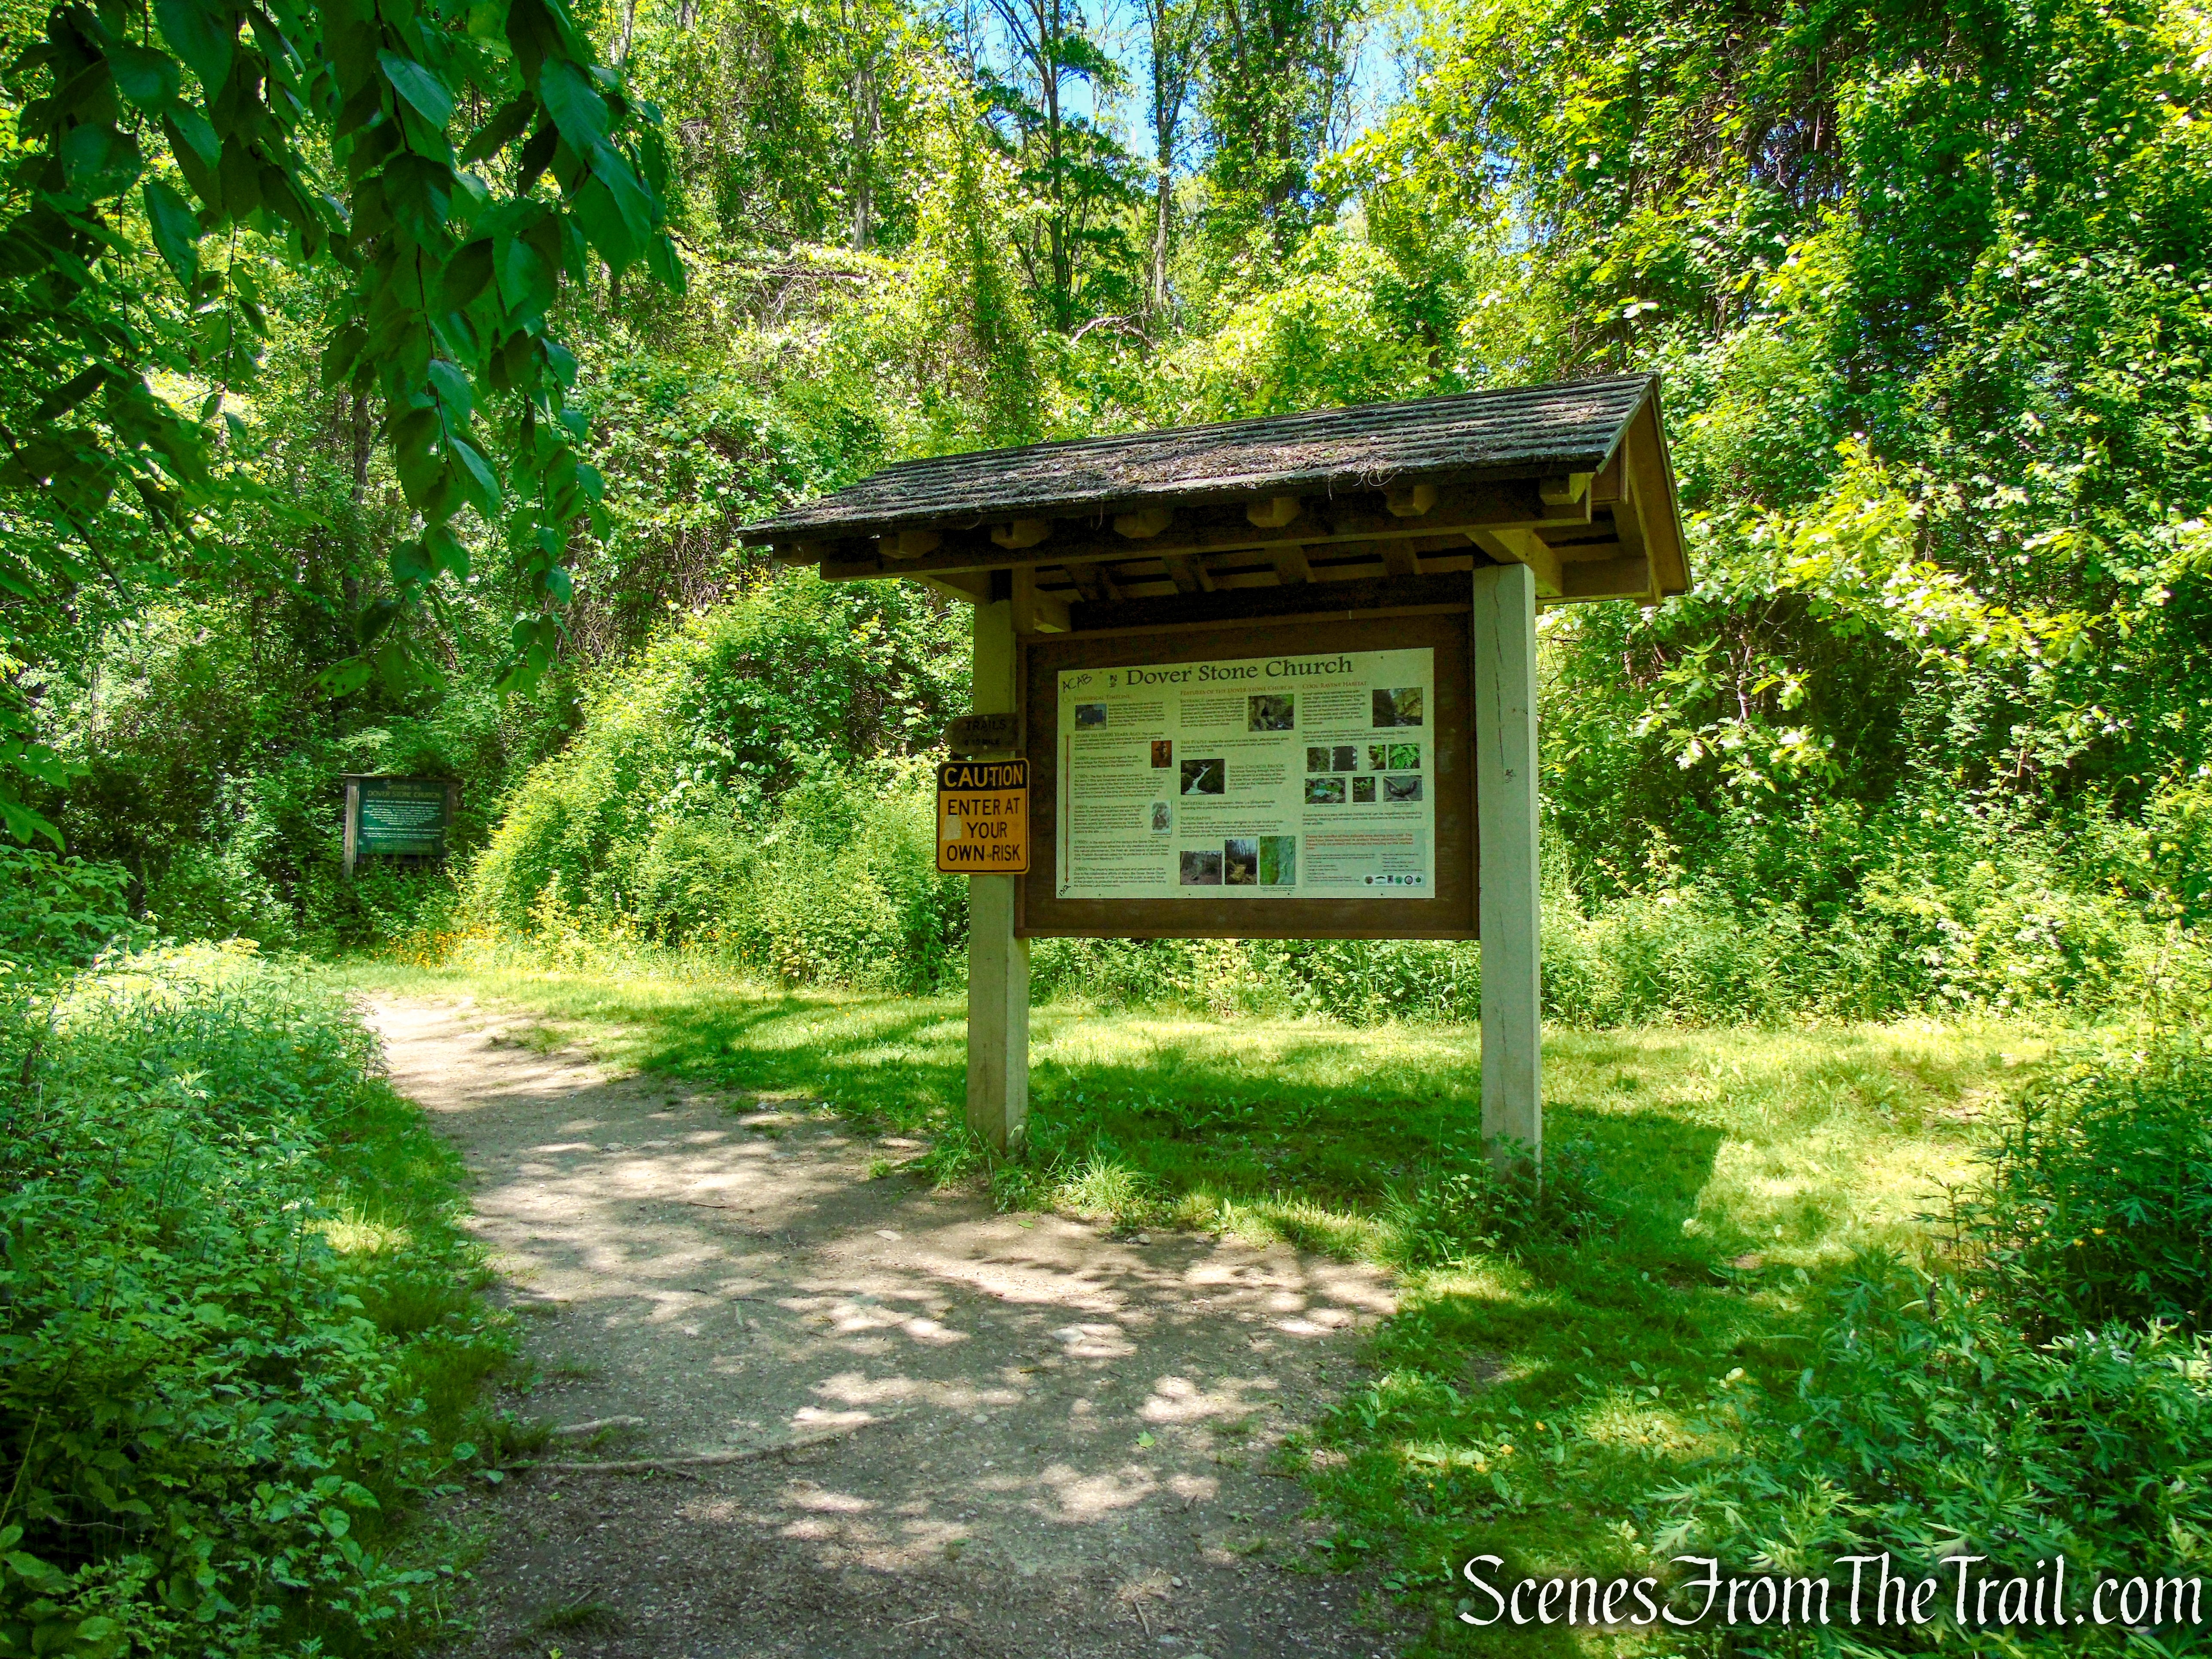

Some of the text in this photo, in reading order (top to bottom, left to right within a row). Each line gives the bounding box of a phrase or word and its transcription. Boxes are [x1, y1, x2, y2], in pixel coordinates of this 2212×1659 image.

[1126, 656, 1353, 685] Dover Stone Church
[1062, 674, 1092, 692] ACAB
[965, 719, 1006, 732] TRAILS
[945, 764, 1023, 787] CAUTION
[948, 797, 1020, 815] ENTER AT
[966, 821, 1007, 839] YOUR
[947, 844, 1021, 861] OWN RISK
